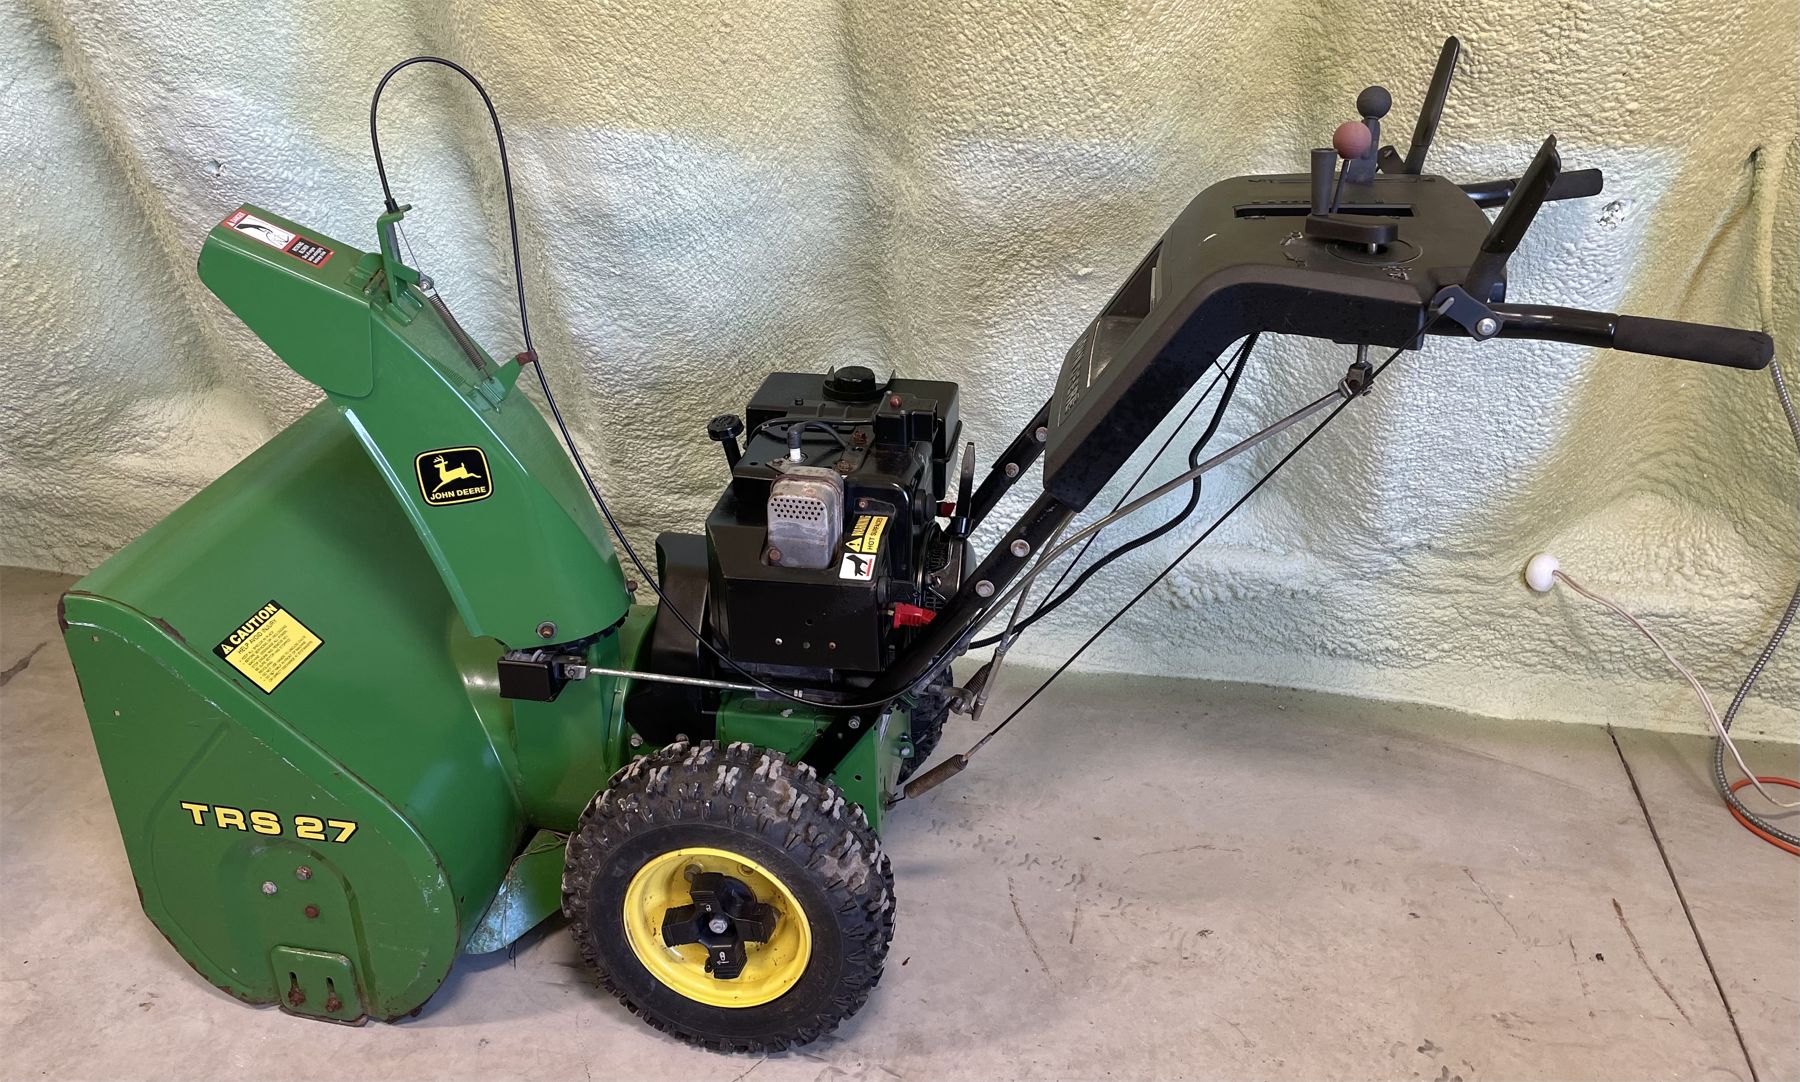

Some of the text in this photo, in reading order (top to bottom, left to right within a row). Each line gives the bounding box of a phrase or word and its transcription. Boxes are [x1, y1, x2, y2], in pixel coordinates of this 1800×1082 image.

[430, 486, 487, 500] JOHN DEERE
[867, 537, 875, 550] HOT
[229, 603, 278, 645] CAUTION
[238, 619, 277, 654] HELP AVOID INJURY
[180, 801, 359, 843] TRS 27
